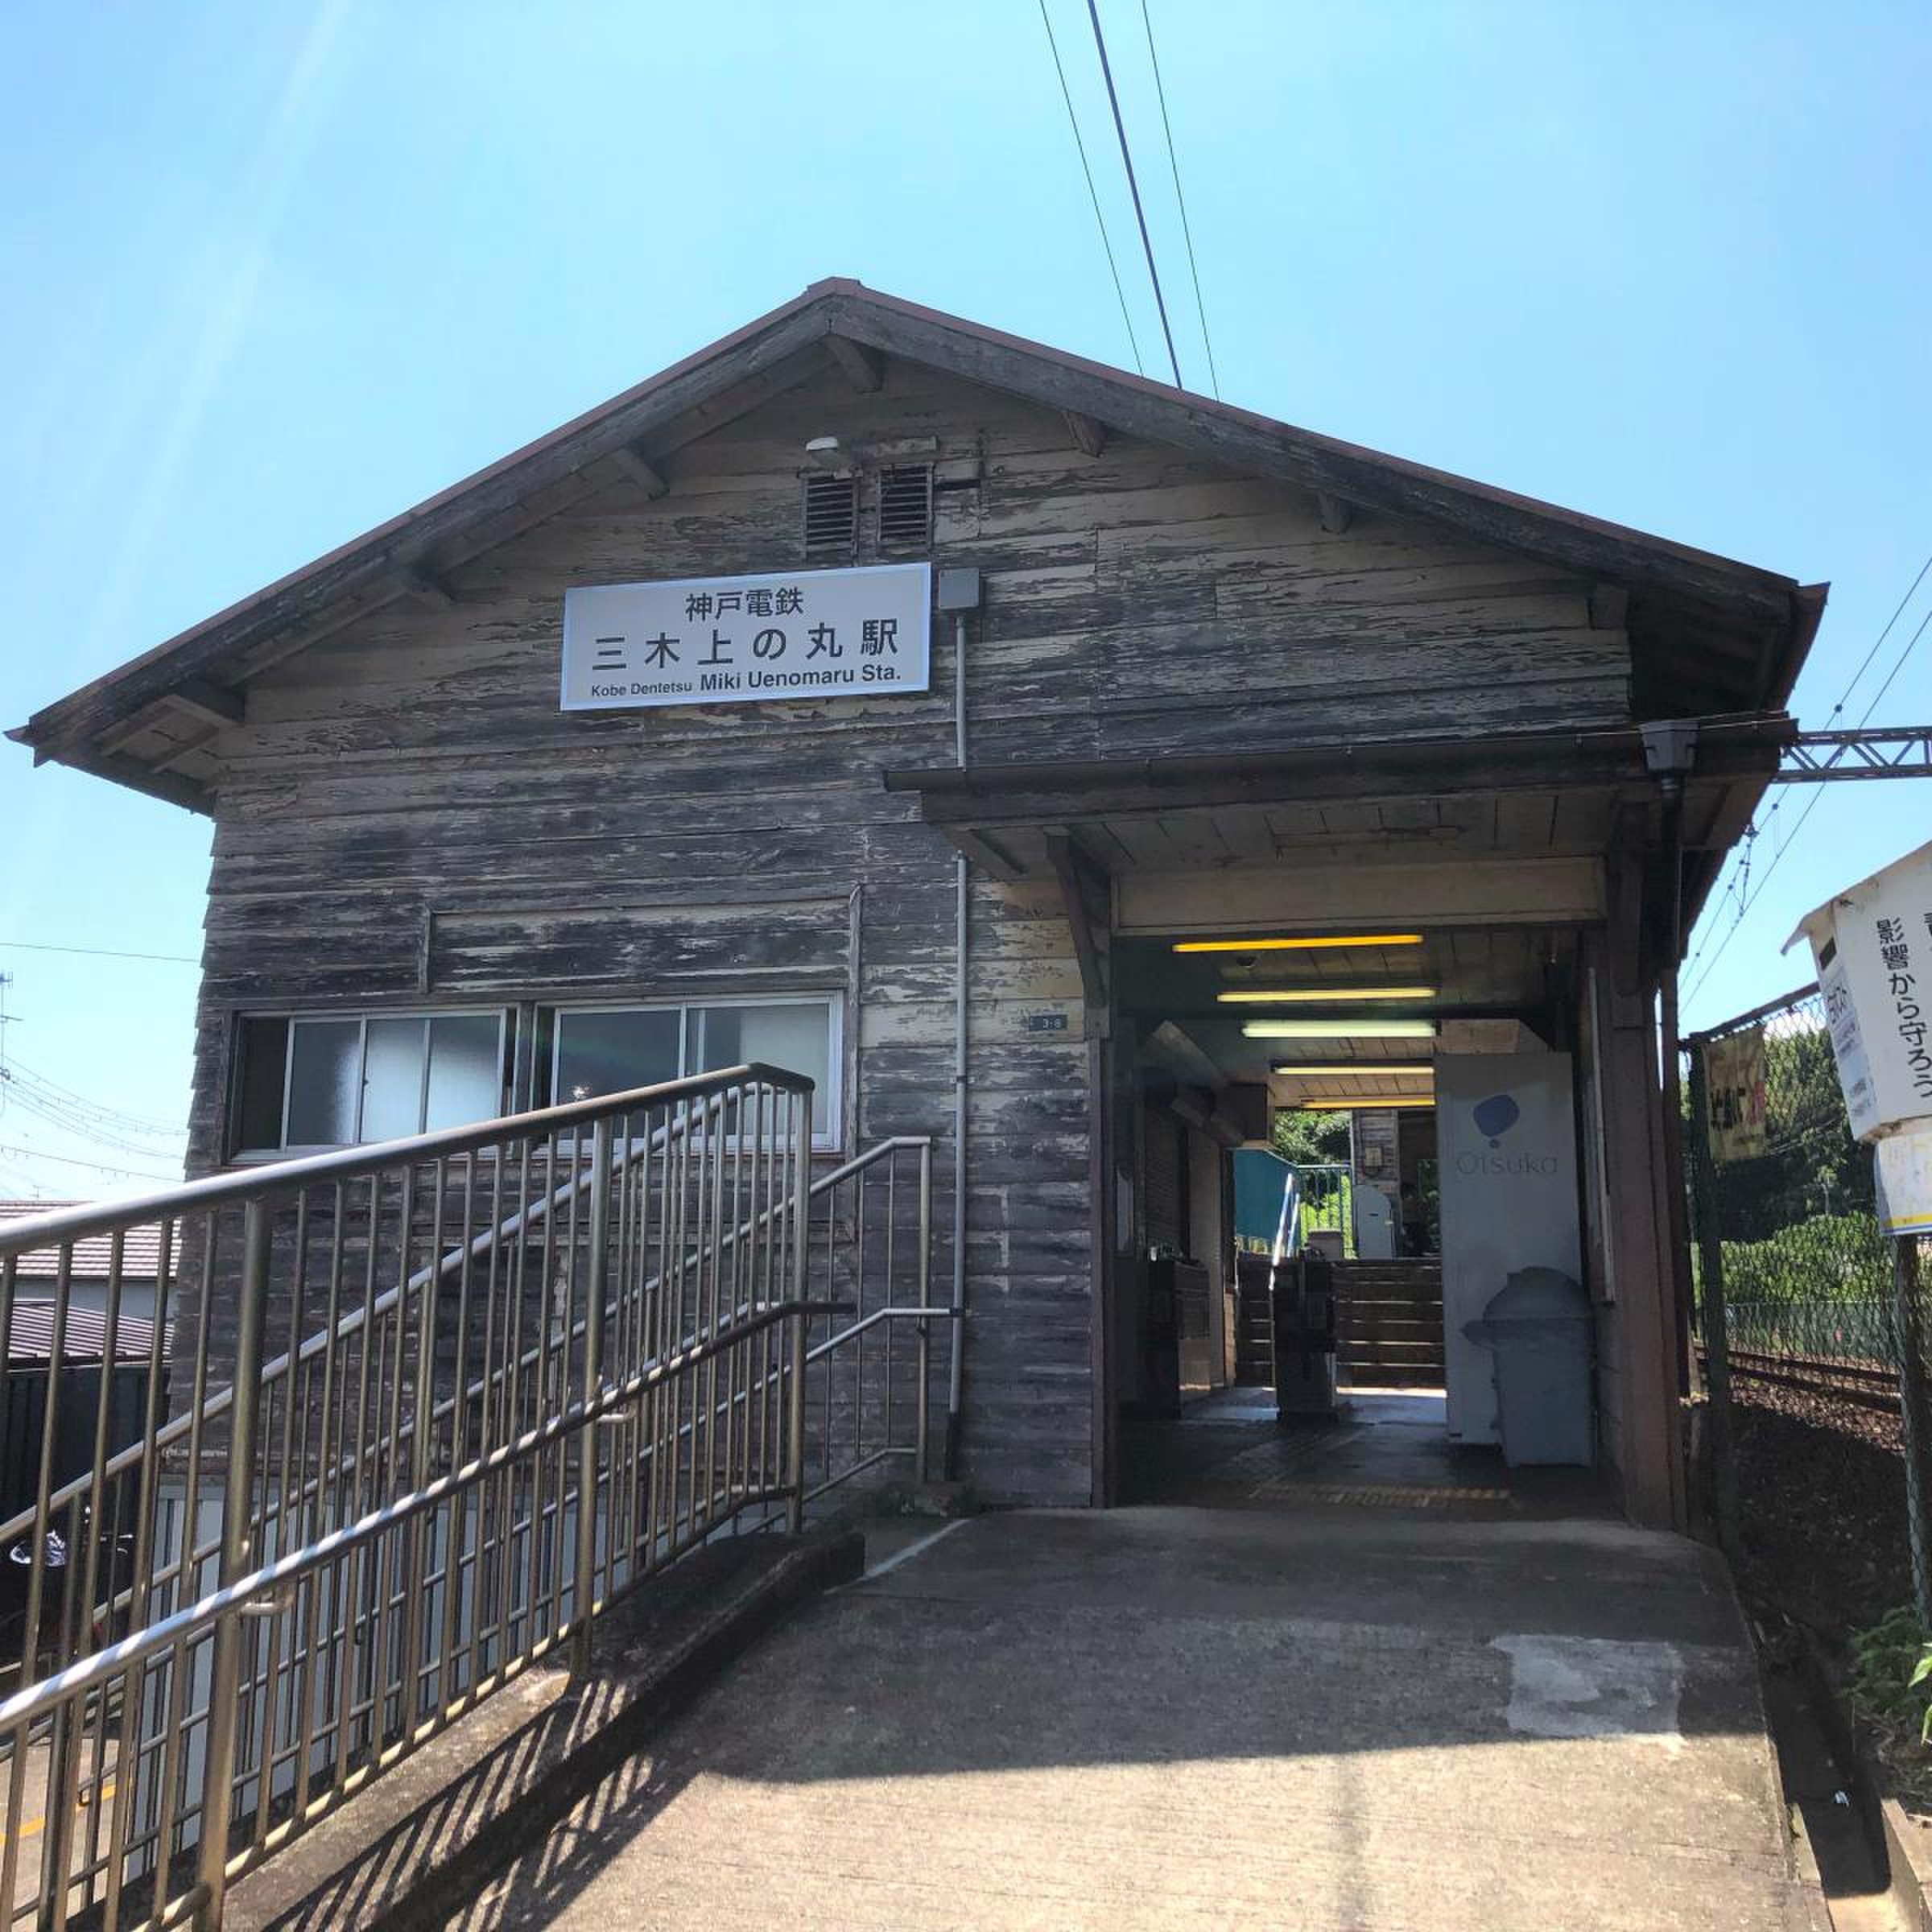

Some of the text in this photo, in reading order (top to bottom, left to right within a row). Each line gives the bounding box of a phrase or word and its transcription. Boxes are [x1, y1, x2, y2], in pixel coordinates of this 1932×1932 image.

[684, 586, 804, 622] 神戸電鉄
[592, 617, 899, 671] 三木上の丸駅
[592, 663, 902, 697] Kobe Dentetsu Miki Uenomaru Sta.
[1456, 1152, 1558, 1174] Otsuka
